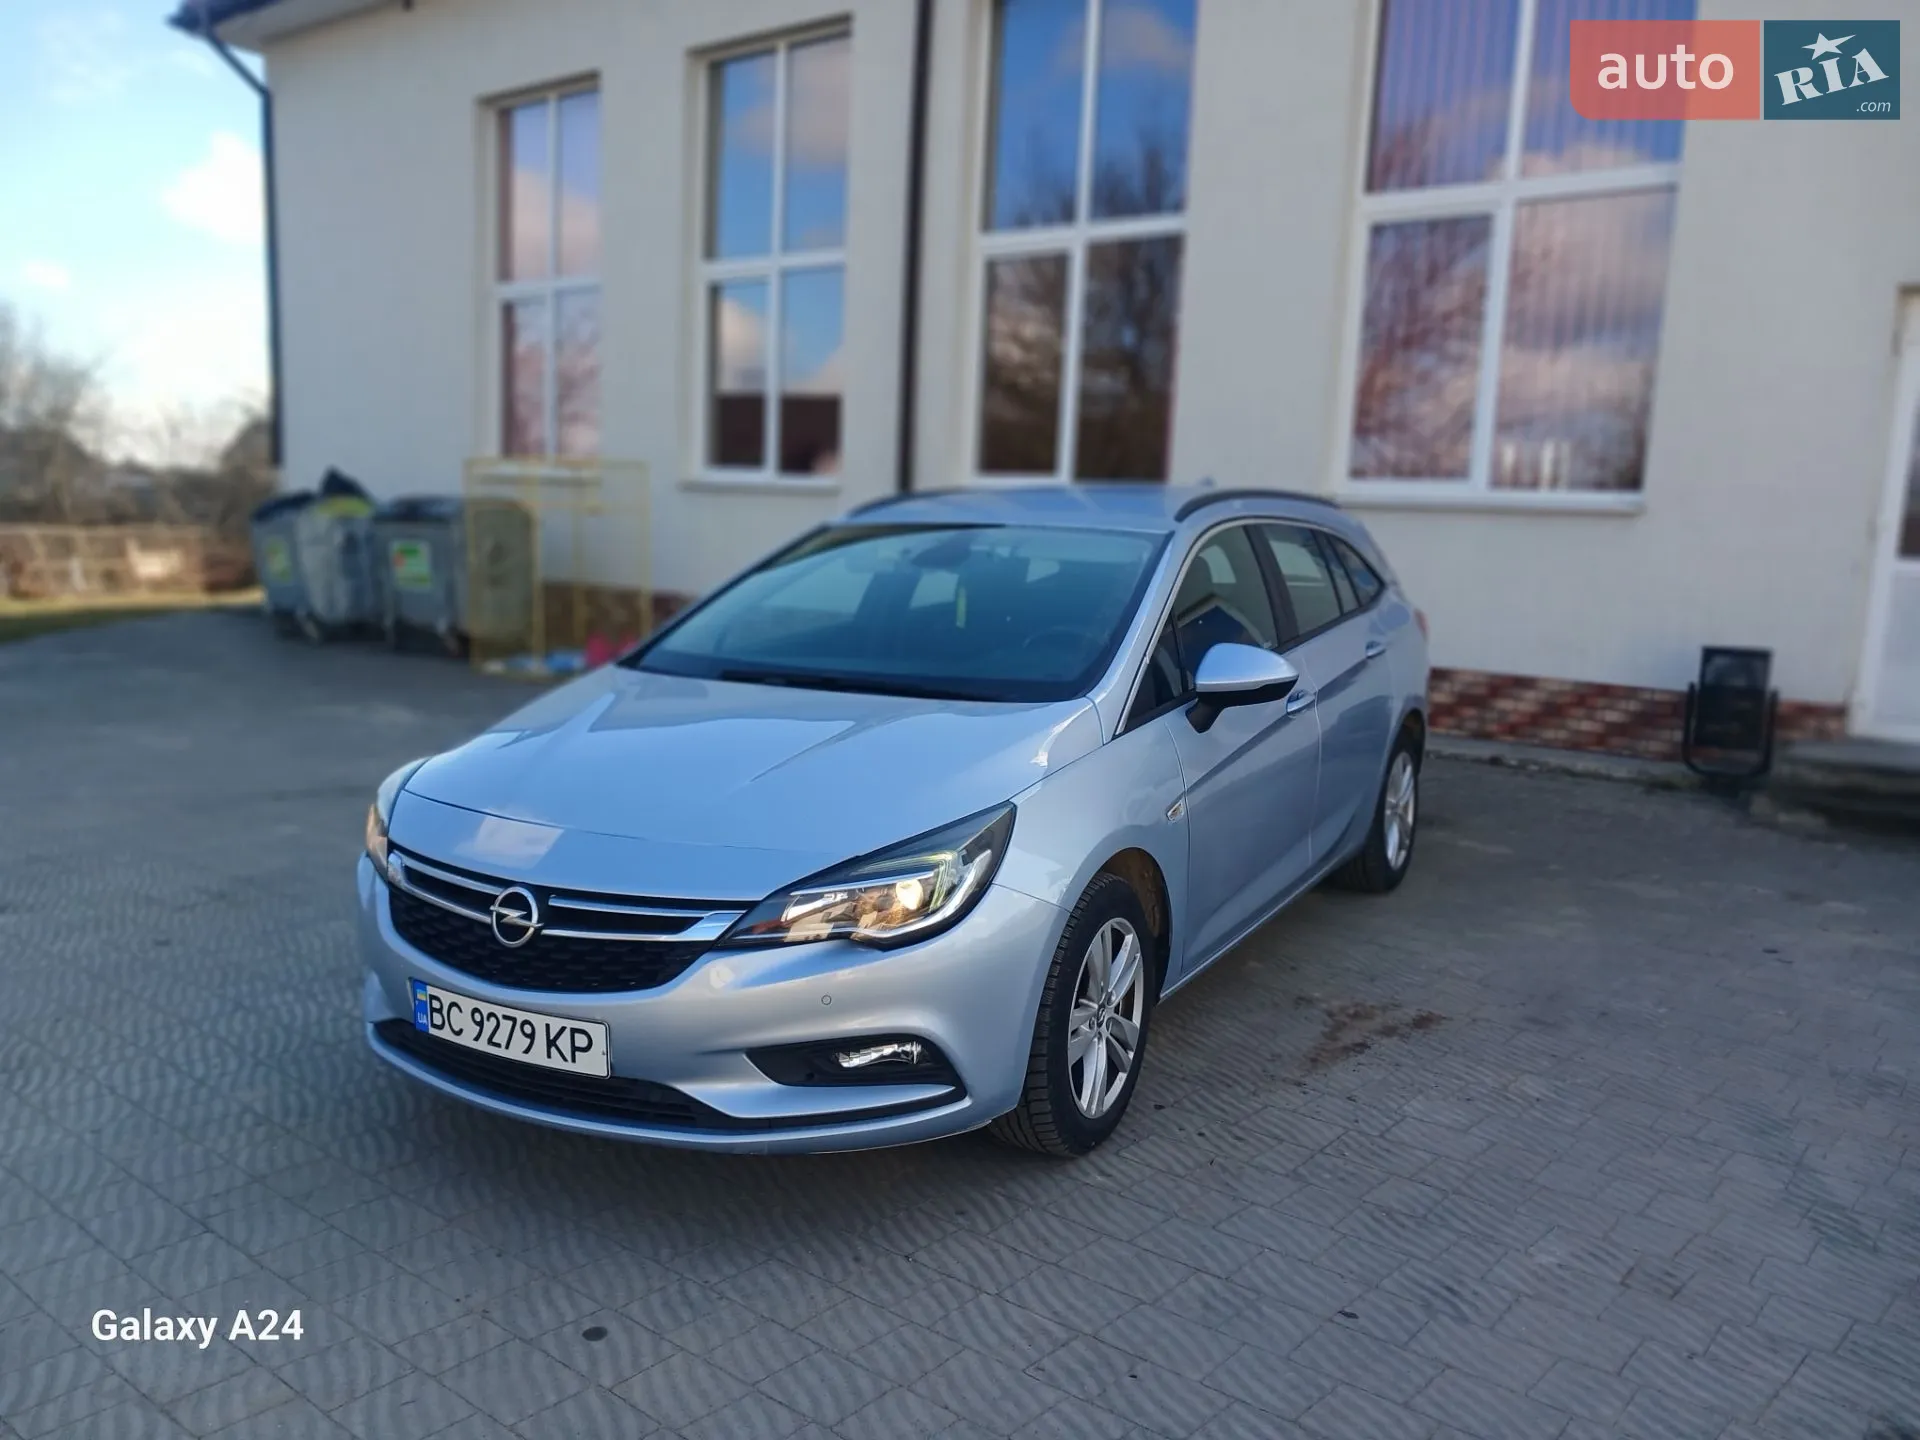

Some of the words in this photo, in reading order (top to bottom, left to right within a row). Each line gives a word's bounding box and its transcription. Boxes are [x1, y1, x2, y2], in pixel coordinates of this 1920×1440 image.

[428, 994, 464, 1036] BC
[471, 1007, 536, 1055] 9279
[545, 1023, 593, 1064] KP
